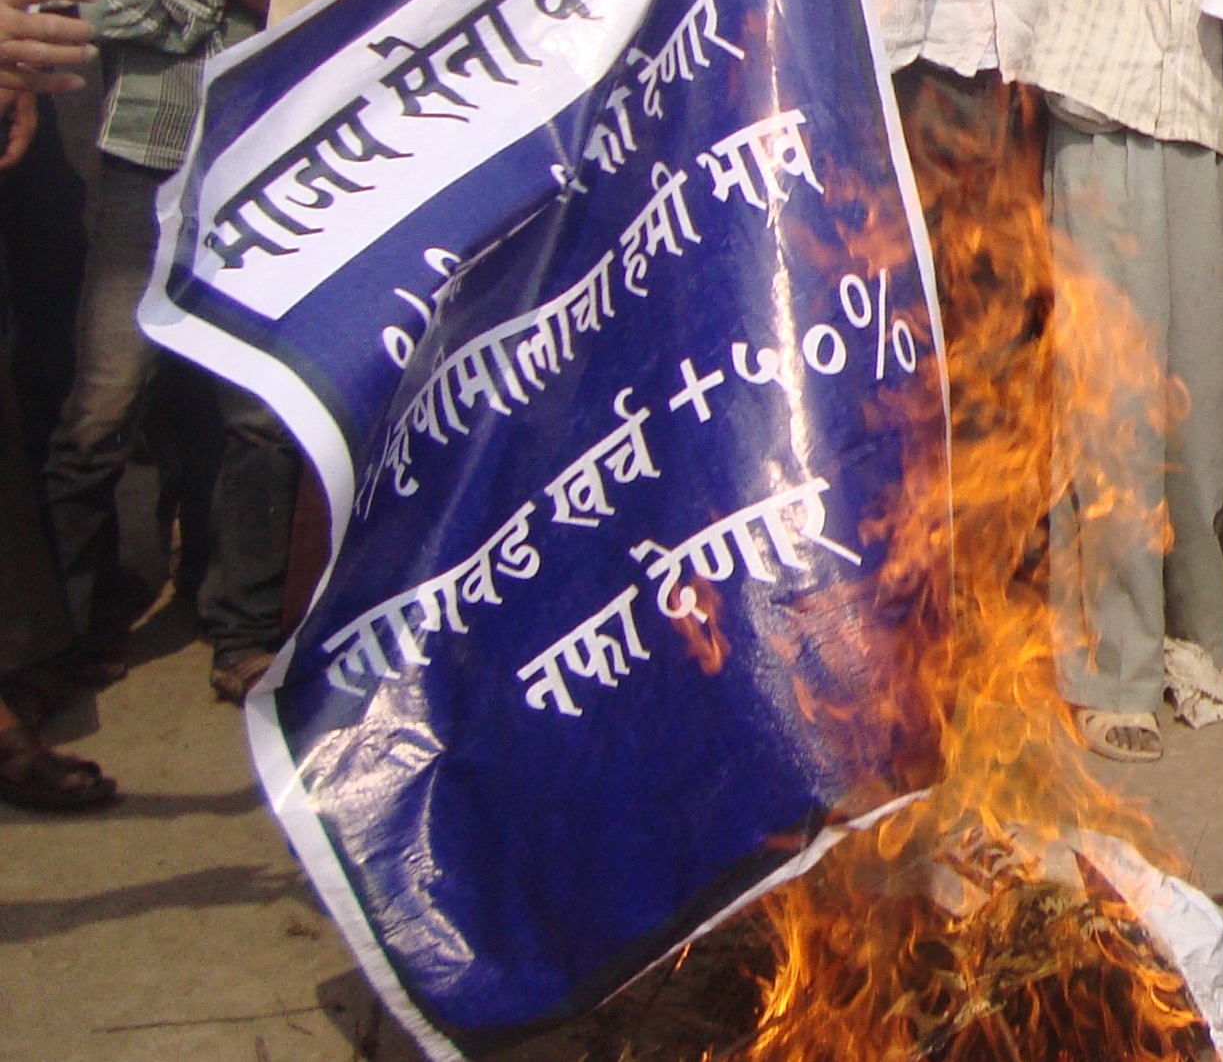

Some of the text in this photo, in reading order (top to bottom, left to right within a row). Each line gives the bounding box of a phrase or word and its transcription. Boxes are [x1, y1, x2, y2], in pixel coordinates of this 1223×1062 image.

[204, 95, 414, 269] भाजप
[619, 160, 702, 298] हमी
[696, 108, 825, 211] भाव
[323, 500, 541, 698] लागवड
[544, 386, 661, 528] खर्च
[516, 476, 863, 717] नफा देणार
